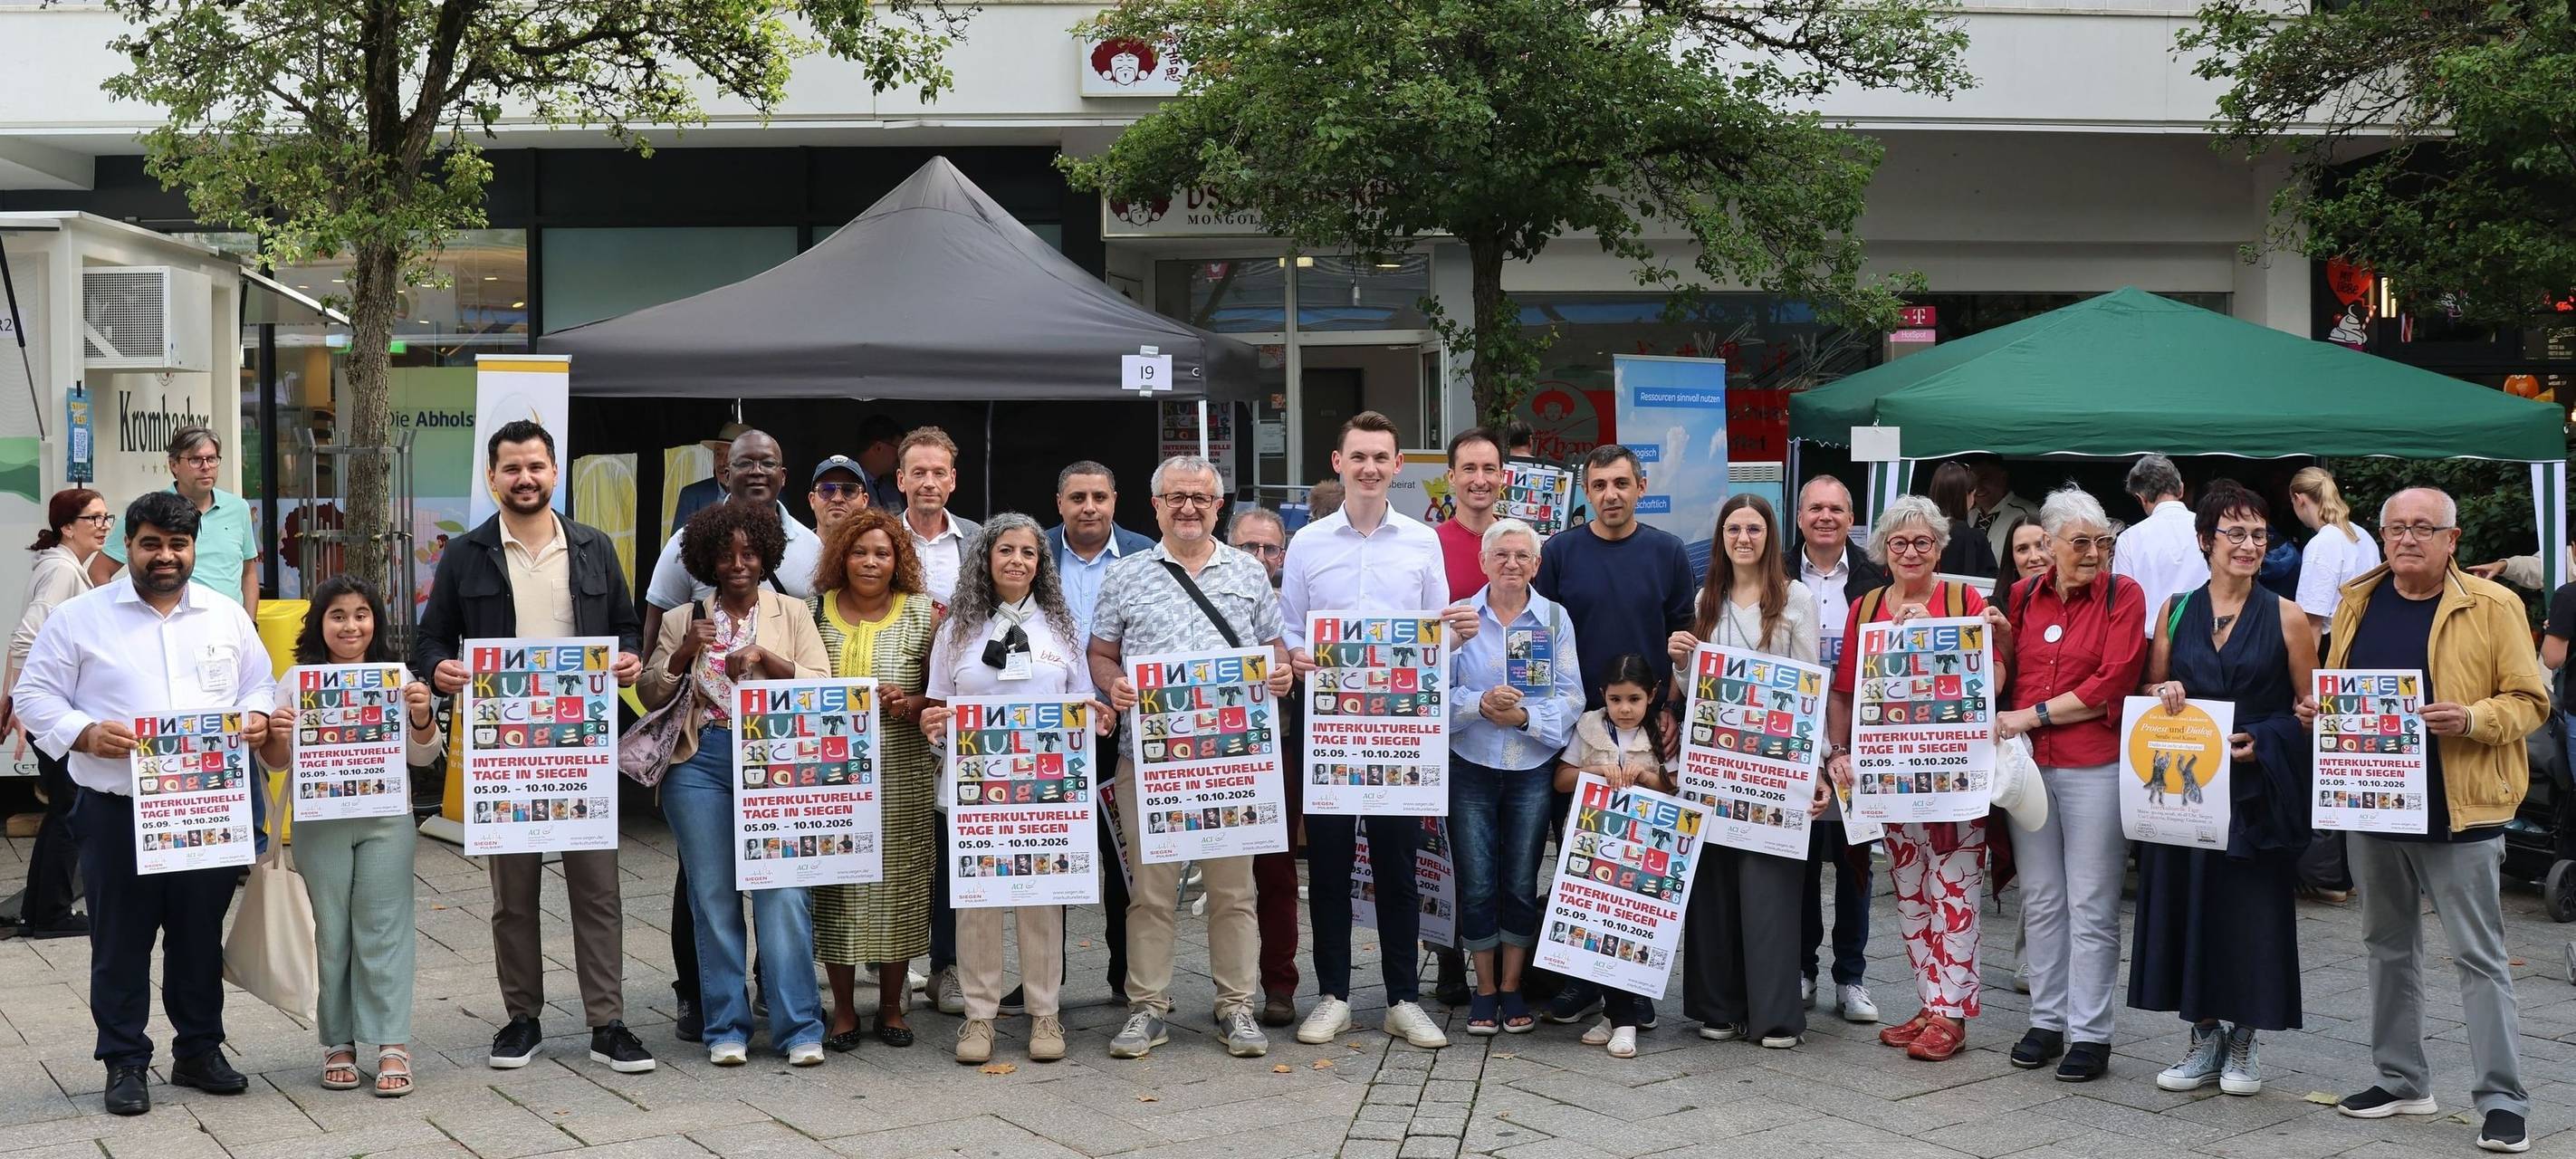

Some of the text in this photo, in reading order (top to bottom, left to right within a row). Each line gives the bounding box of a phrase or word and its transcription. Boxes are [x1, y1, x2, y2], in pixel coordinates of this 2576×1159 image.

[1640, 391, 1720, 404] Ressourcen sinnvoll nutzen
[416, 411, 475, 427] Abhols
[1313, 723, 1441, 733] INTERKULTURELLE
[1313, 735, 1420, 745] TAGE IN SIEGEN
[1859, 730, 1987, 742] INTERKULTURELLE
[300, 746, 400, 759] INTERKULTURELLE
[1362, 751, 1420, 759] 10.10.2026
[1859, 742, 1968, 755] TAGE IN SIEGEN
[300, 756, 385, 769] TAGE IN SIEGEN
[473, 754, 608, 768] INTERKULTURELLE
[1688, 752, 1809, 781] INTERKULTURELLE
[1860, 759, 1894, 768] 05.09.
[1909, 756, 1968, 767] 10.10.2026
[2319, 758, 2420, 768] INTERKULTURELLE
[301, 771, 328, 779] 05.09.
[339, 767, 385, 776] 10.10.2026
[474, 767, 588, 781] TAGE IN SIEGEN
[1144, 761, 1274, 781] INTERKULTURELLE
[1687, 763, 1788, 790] TAGE IN SIEGEN
[2320, 768, 2346, 776] TAGE
[2366, 769, 2404, 777] SIEGEN
[474, 784, 511, 795] 05.09.
[525, 782, 588, 793] 10.10.2026
[1145, 774, 1255, 794] TAGE IN SIEGEN
[1685, 777, 1718, 790] 05.09.
[1730, 785, 1786, 801] 10.10.2026
[140, 793, 245, 809] INTERKULTURELLE
[743, 791, 873, 807] INTERKULTURELLE
[1146, 795, 1182, 807] 05.09.
[1196, 789, 1255, 803] 10.10.2026
[141, 804, 229, 819] TAGE IN SIEGEN
[743, 804, 853, 819] TAGE IN SIEGEN
[957, 809, 1088, 823] INTERKULTURELLE
[142, 820, 171, 829] 05.09.
[182, 815, 230, 826] 10.10.2026
[744, 822, 780, 833] 05.09.
[794, 819, 853, 830] 10.10.2026
[958, 822, 1068, 837] TAGE IN SIEGEN
[958, 839, 994, 849] 05.09.
[1009, 837, 1068, 848] 10.10.2026
[1561, 880, 1678, 921] INTERKULTURELLE
[1558, 893, 1658, 927] TAGE IN SIEGEN
[1556, 906, 1589, 922] 05.09.
[1601, 918, 1655, 939] 10.10.2026
